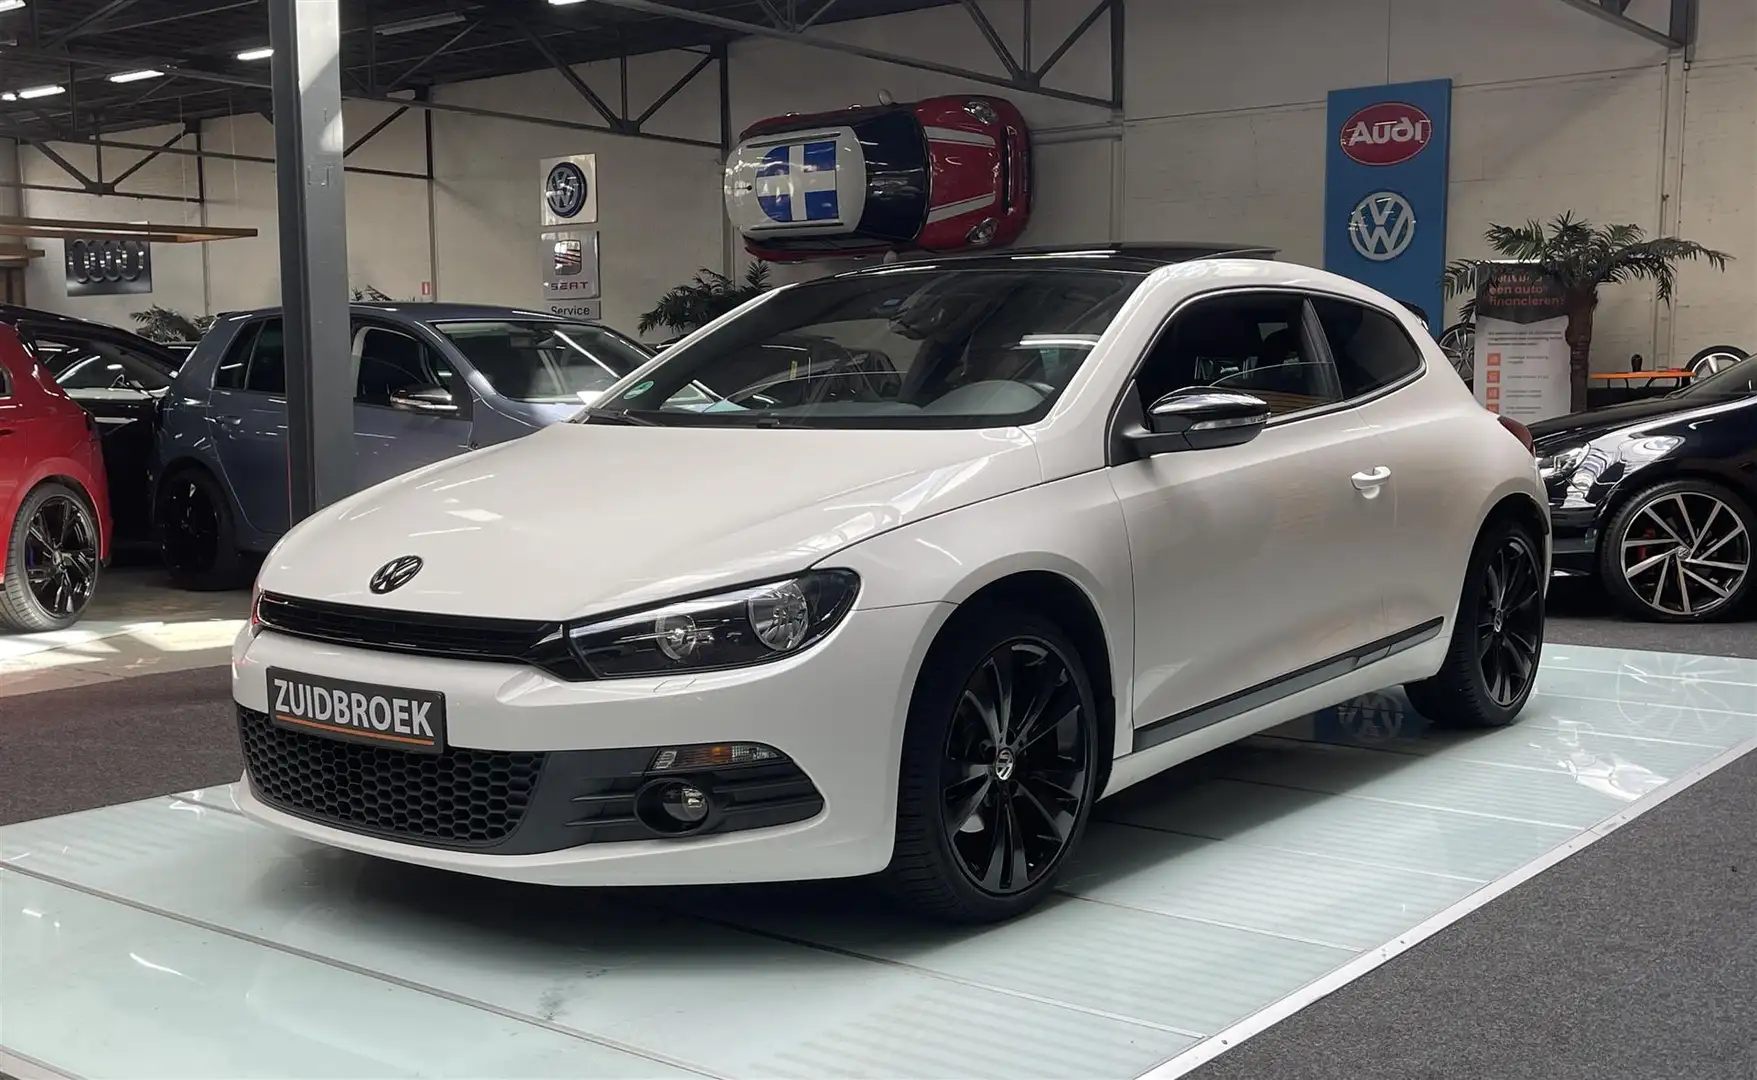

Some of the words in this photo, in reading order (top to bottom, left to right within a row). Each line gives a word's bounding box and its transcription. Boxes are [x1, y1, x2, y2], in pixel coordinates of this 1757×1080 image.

[1349, 117, 1423, 146] Audi
[1352, 193, 1414, 260] VW
[551, 281, 588, 290] SEAT
[1514, 284, 1543, 294] auto
[551, 305, 590, 316] Service
[274, 678, 434, 737] ZUIDBROEK
